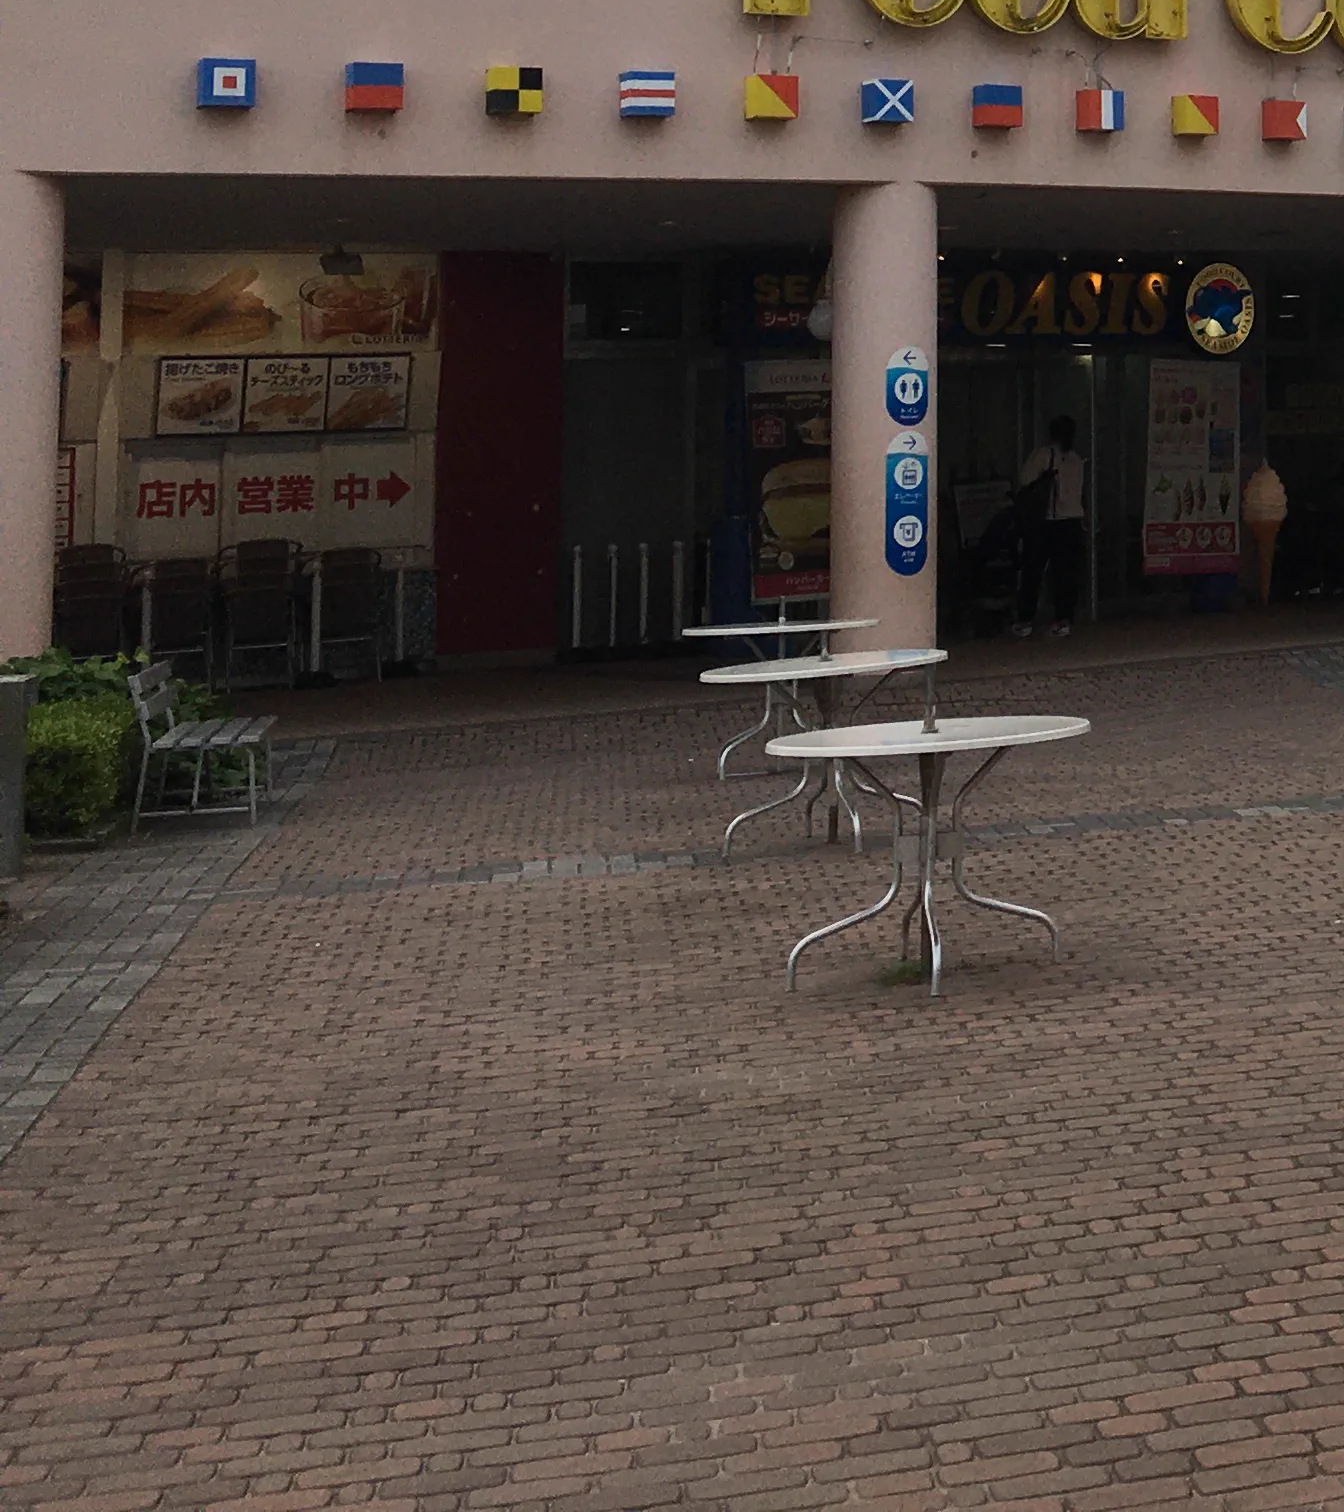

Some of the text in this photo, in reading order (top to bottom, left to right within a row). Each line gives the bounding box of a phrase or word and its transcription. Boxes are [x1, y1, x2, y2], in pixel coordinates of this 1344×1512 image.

[961, 270, 1170, 336] OASIS
[250, 374, 323, 386] チーズスティック
[136, 472, 370, 519] 店内 営業 中
